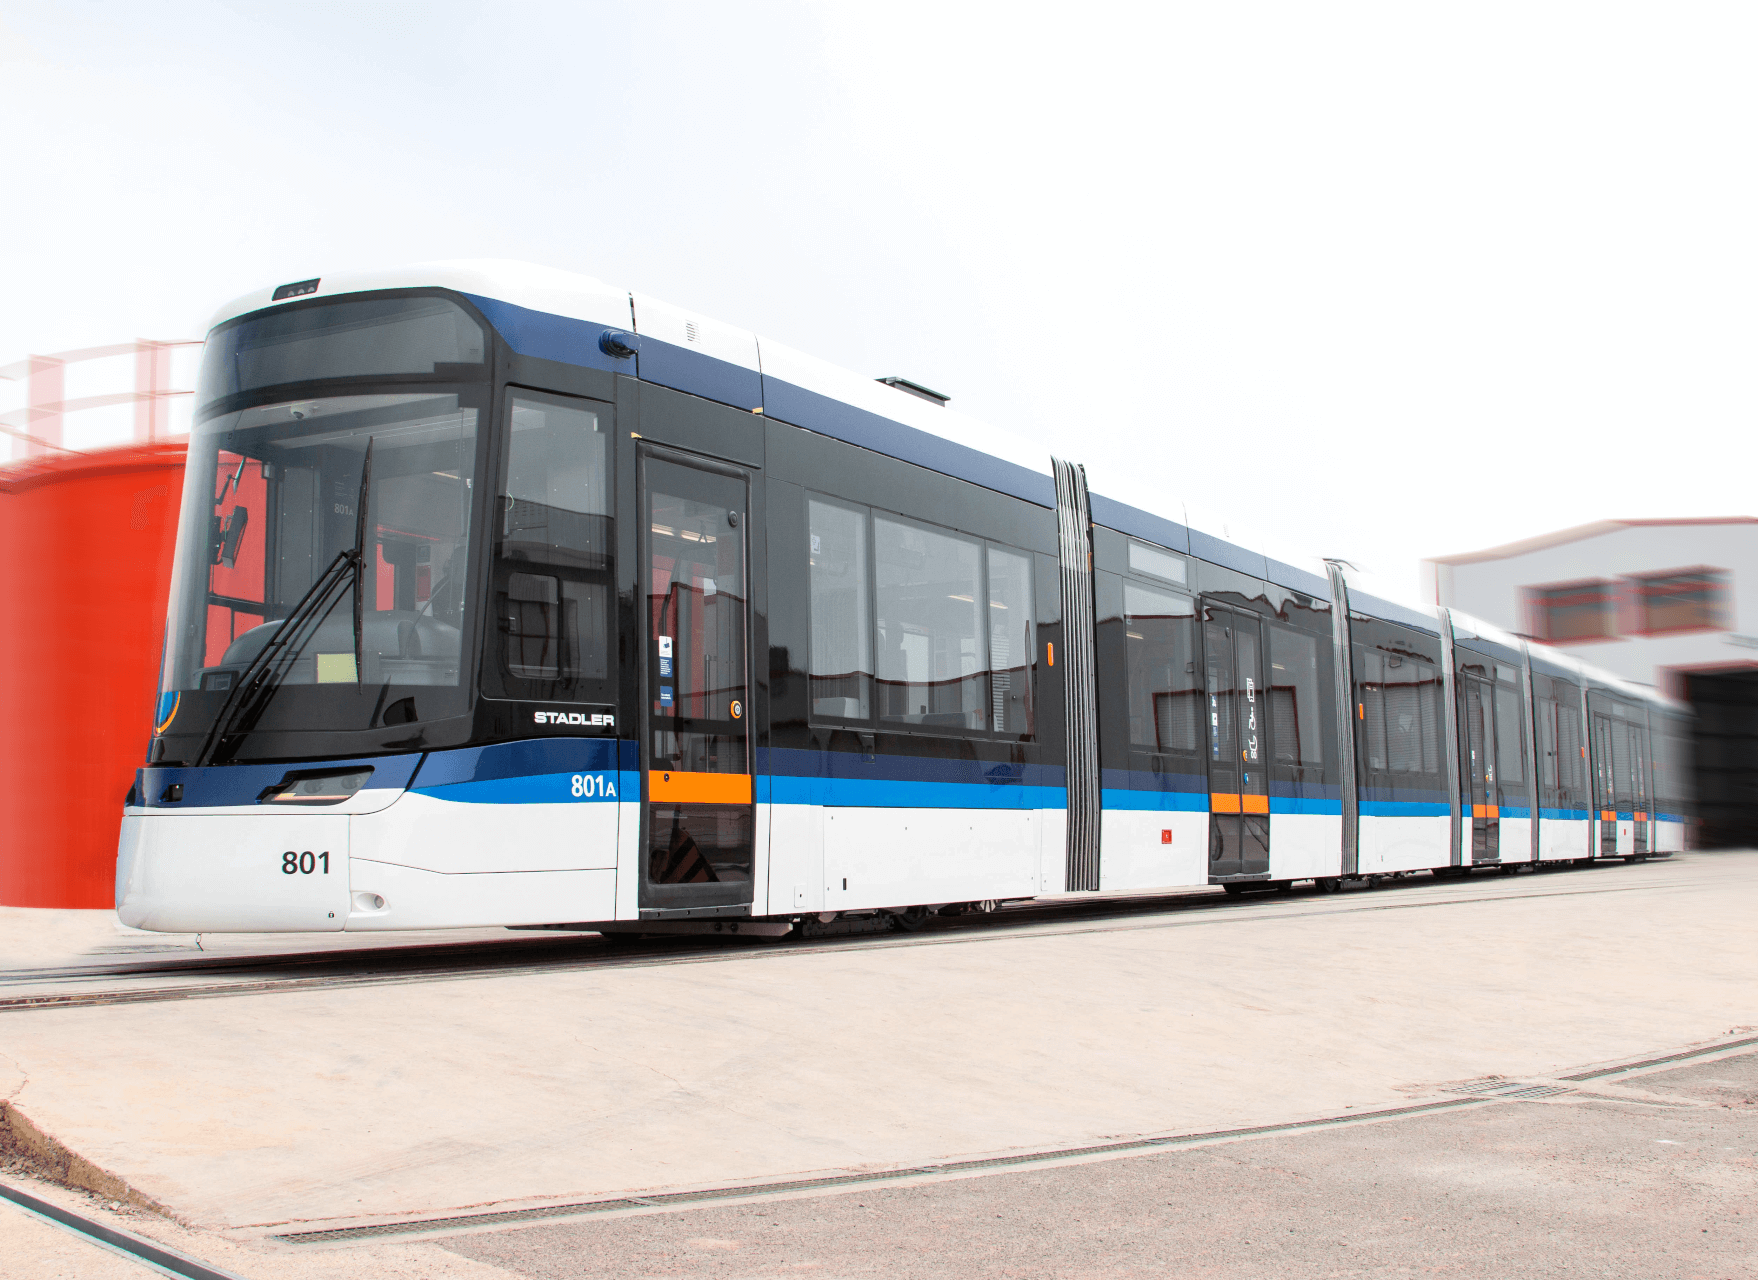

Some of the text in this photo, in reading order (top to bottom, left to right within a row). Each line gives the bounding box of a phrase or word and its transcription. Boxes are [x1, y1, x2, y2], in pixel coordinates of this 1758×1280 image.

[334, 503, 354, 517] 801A
[534, 711, 615, 726] STADLER
[571, 774, 617, 797] 801A
[282, 850, 330, 875] 801
